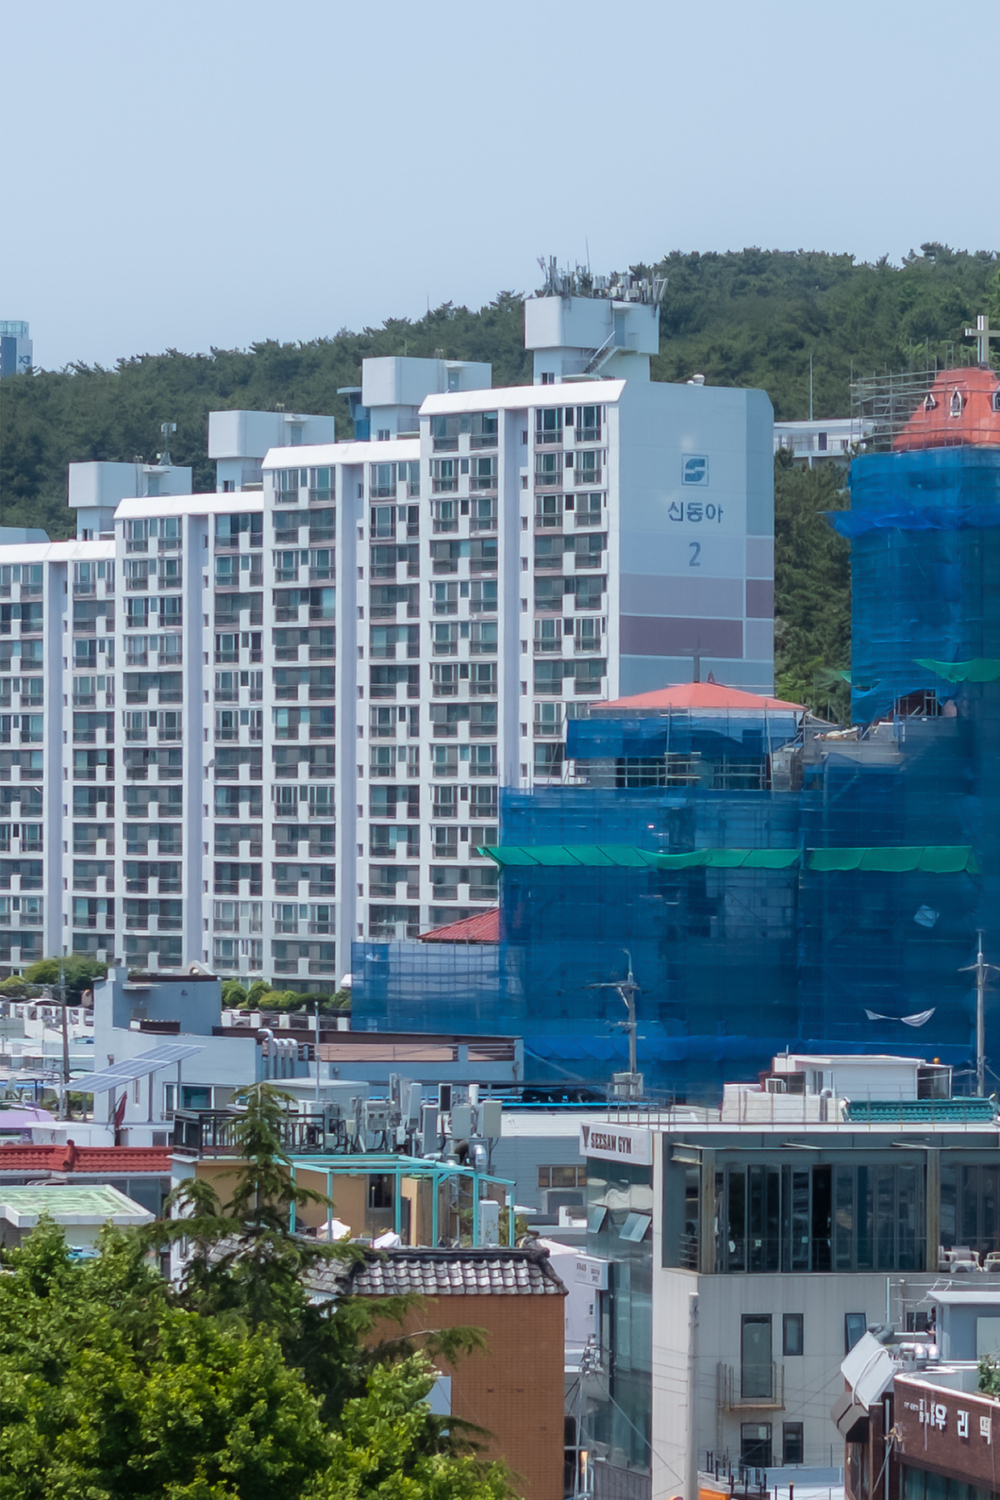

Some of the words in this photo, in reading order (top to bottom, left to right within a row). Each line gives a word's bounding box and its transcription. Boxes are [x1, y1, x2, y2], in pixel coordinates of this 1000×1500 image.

[667, 501, 724, 524] 신동아
[688, 541, 701, 567] 2
[618, 1135, 632, 1155] GYM
